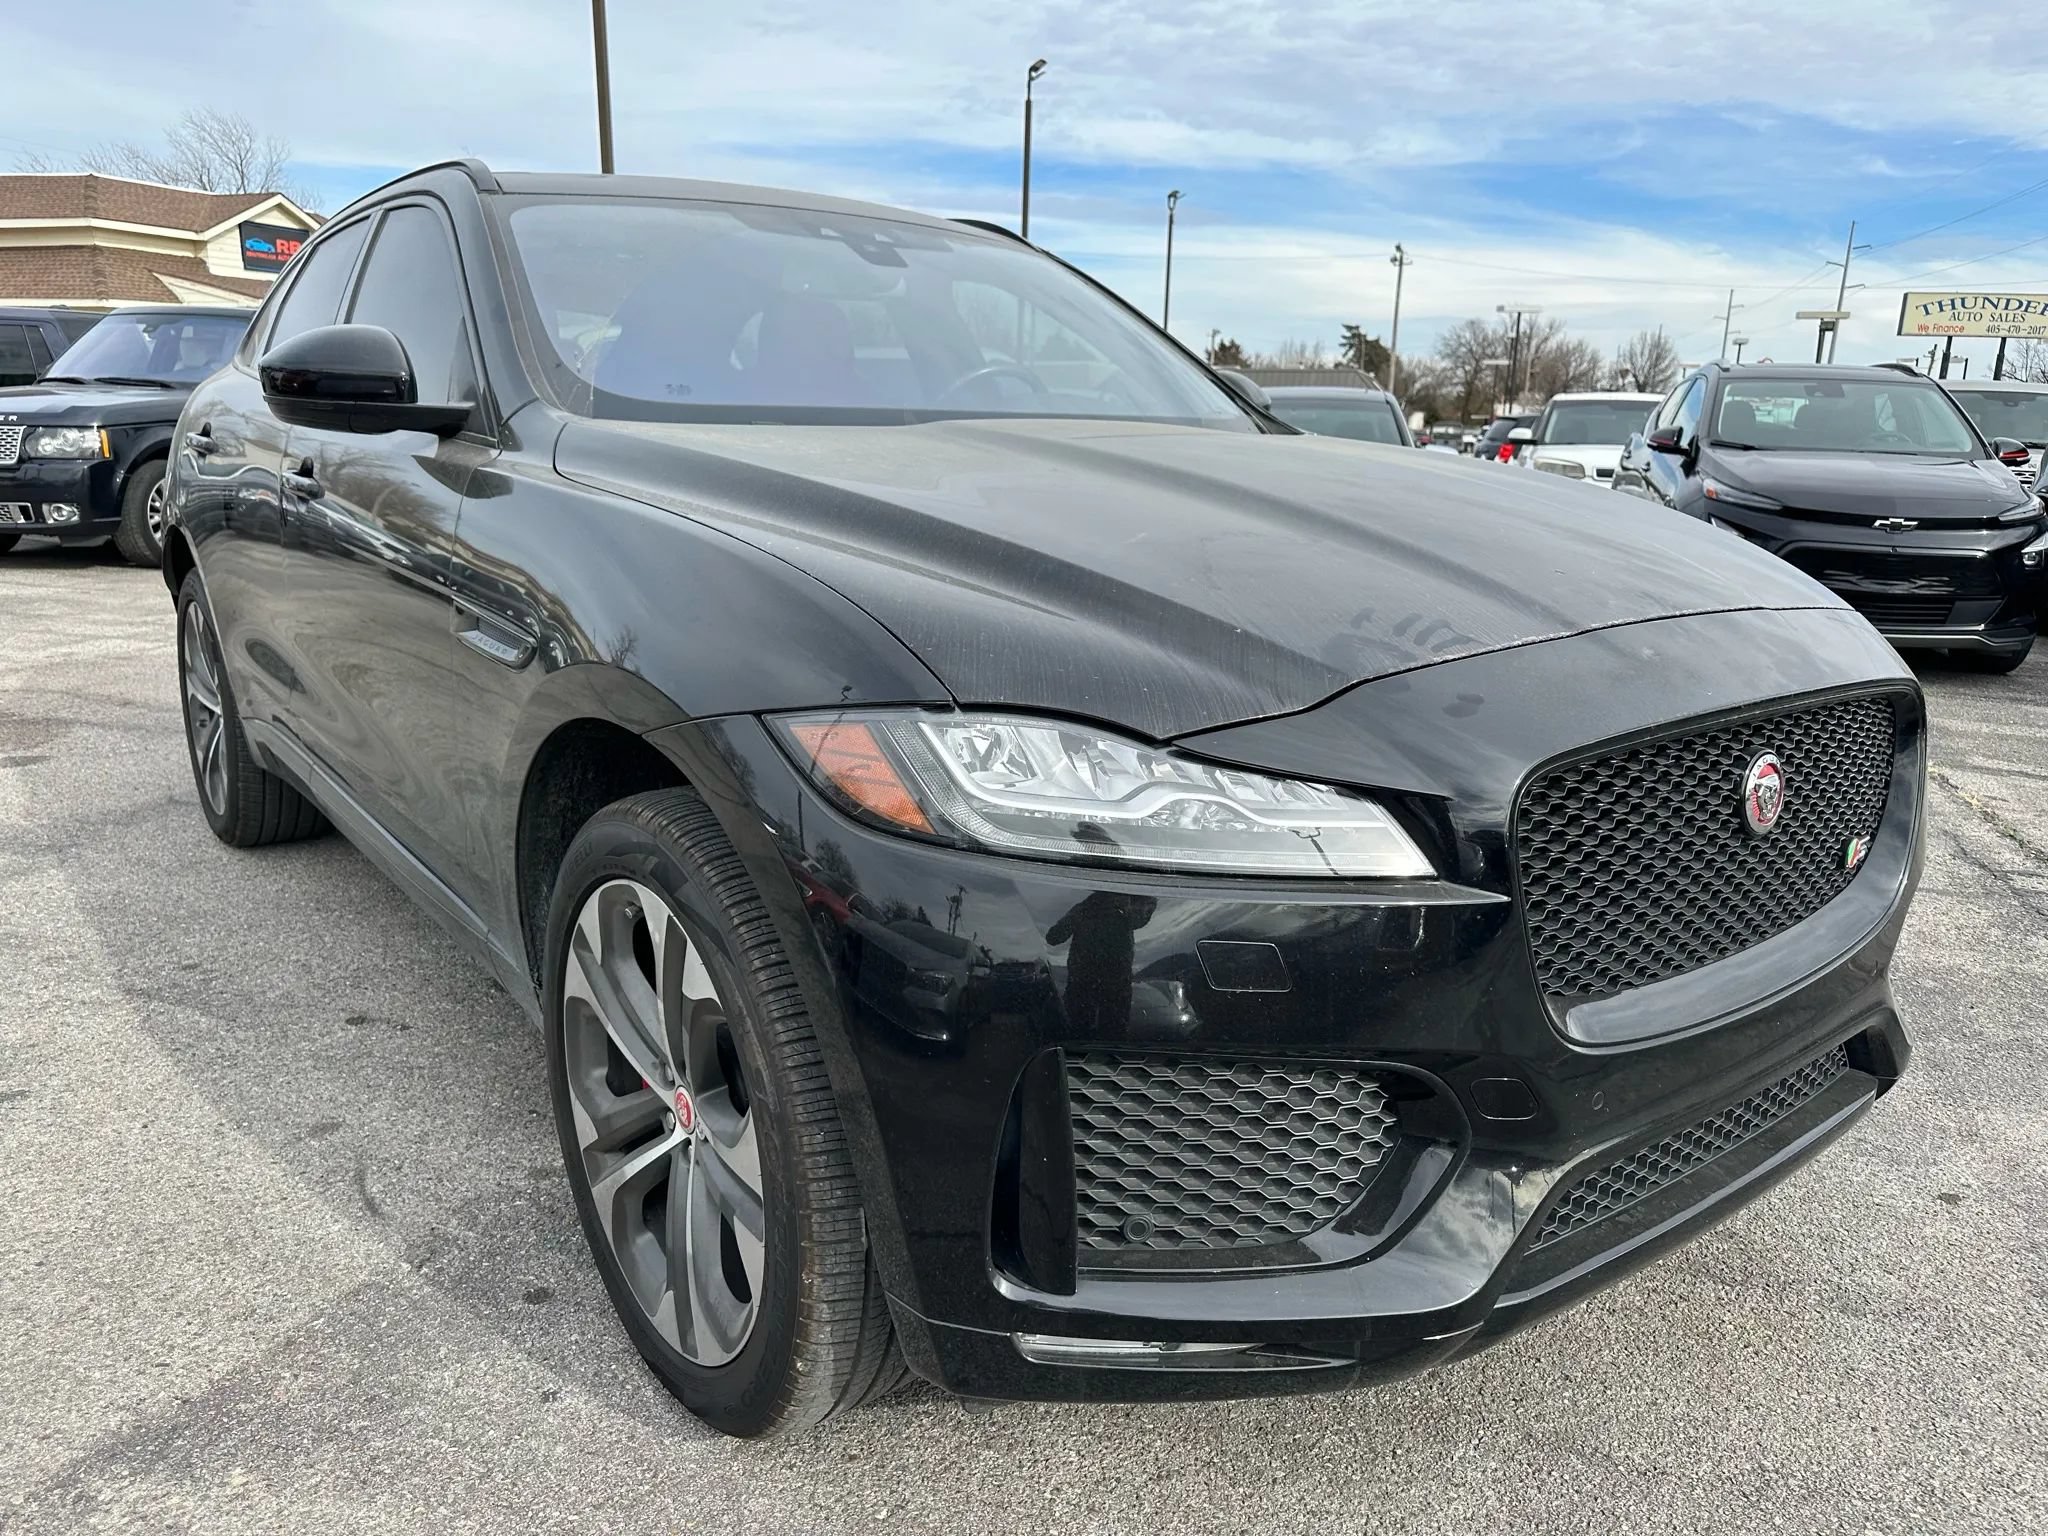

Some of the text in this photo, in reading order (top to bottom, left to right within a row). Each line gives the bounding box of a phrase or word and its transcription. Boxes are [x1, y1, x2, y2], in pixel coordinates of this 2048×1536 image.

[1948, 311, 2027, 323] AUTO SALES
[1917, 323, 1965, 333] We Finance
[1985, 324, 2047, 335] 405-470-2017
